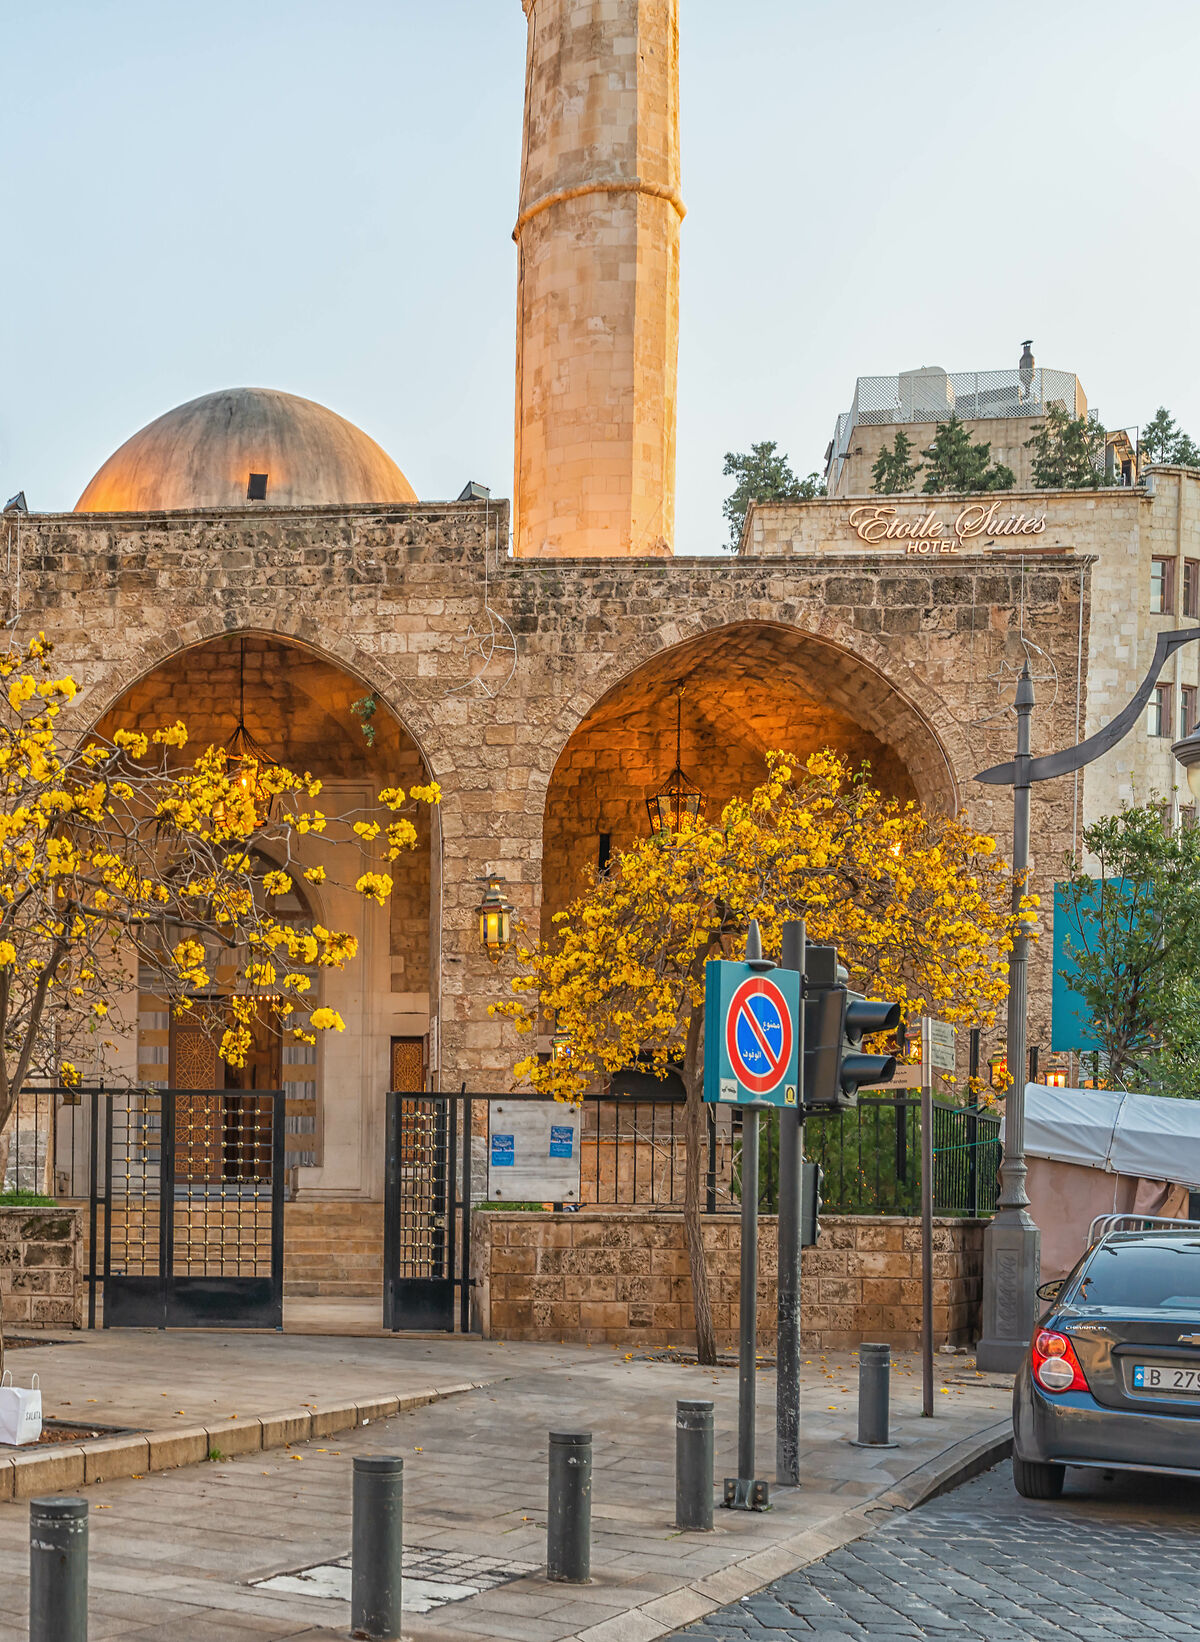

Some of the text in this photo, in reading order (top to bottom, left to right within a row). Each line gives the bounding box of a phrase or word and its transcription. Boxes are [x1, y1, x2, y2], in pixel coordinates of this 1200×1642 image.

[849, 501, 1047, 546] Etoile Suites
[906, 540, 959, 553] HOTEL
[762, 1019, 781, 1032] ممنوع
[742, 1048, 762, 1062] الوقوف
[1150, 1369, 1161, 1386] B
